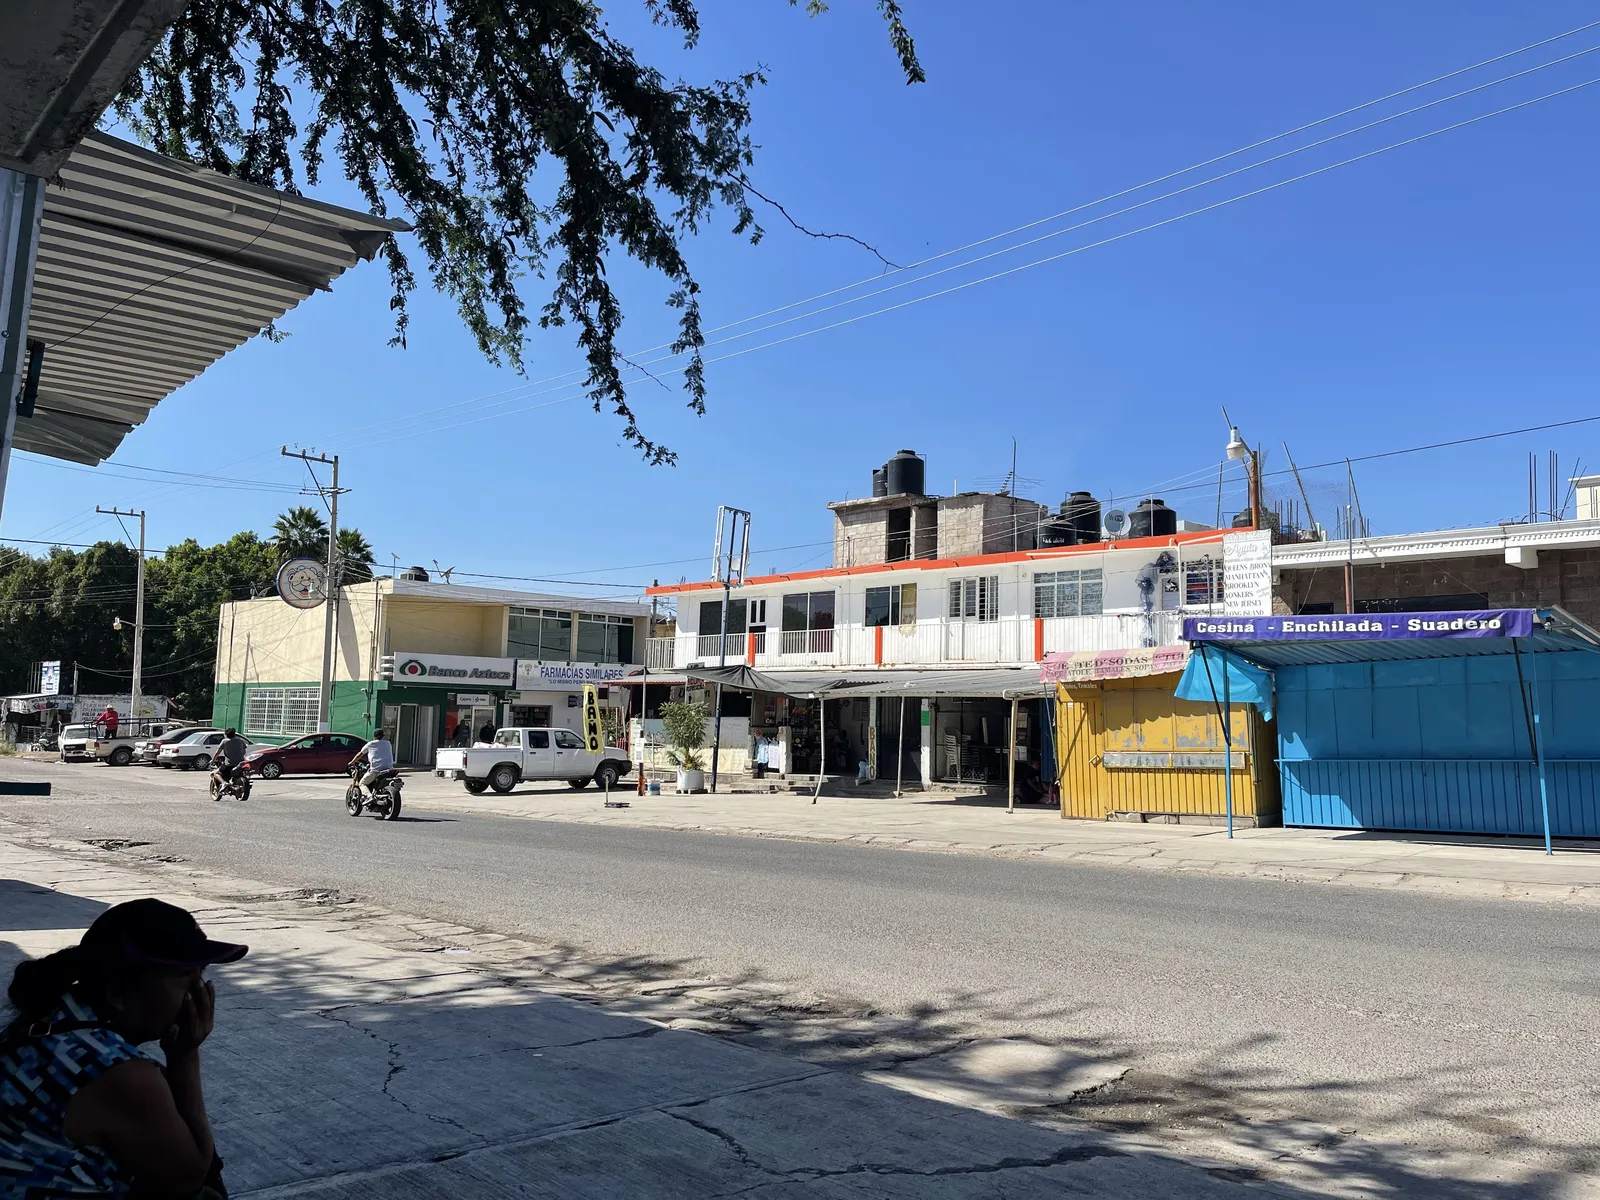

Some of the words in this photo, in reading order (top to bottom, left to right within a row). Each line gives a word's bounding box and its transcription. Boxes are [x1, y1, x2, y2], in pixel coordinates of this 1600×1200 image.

[1224, 564, 1248, 573] QUEENS
[1225, 572, 1265, 581] MANHATTAN
[1224, 581, 1259, 590] BROOKLYN
[1225, 600, 1239, 608] NEW
[1241, 599, 1262, 608] JERSEY
[1196, 621, 1255, 633] Cesina
[1282, 620, 1383, 633] Enchilada
[1407, 618, 1501, 631] Suadero
[428, 665, 468, 678] Banco
[468, 668, 511, 680] Azteca
[540, 667, 584, 679] FARMACIAS
[585, 668, 624, 680] SIMILARES
[587, 691, 599, 750] BAÑO
